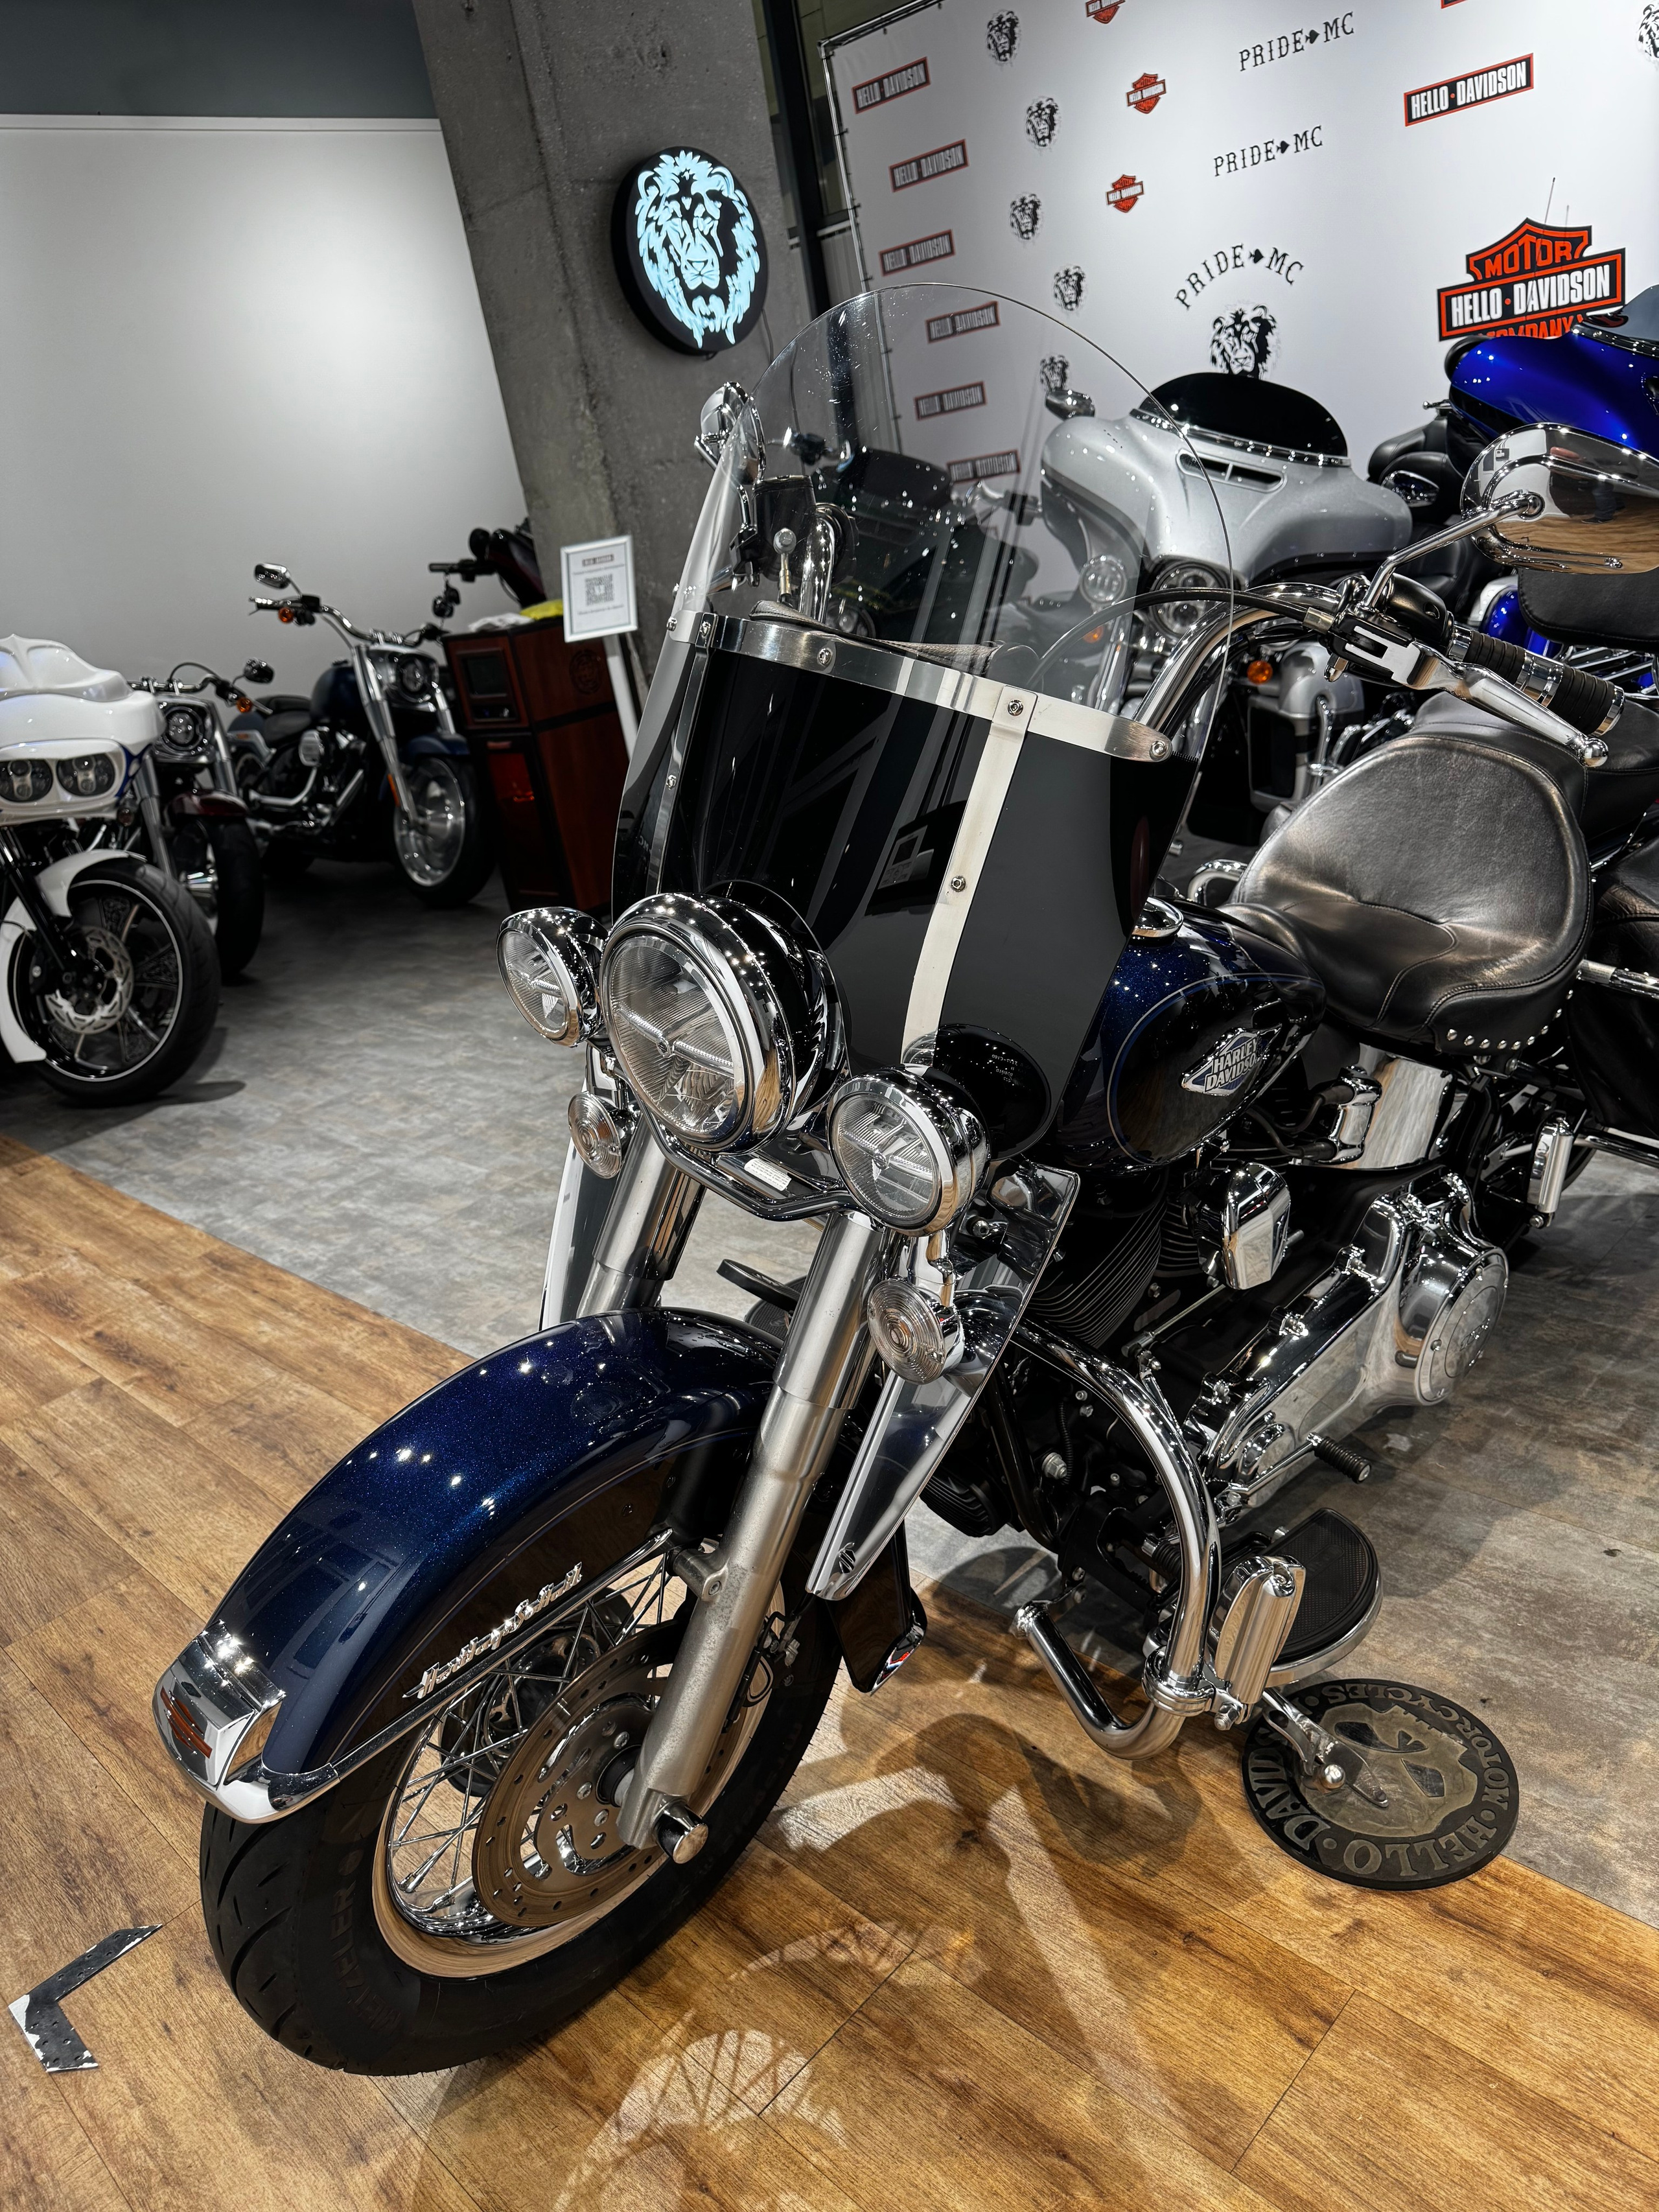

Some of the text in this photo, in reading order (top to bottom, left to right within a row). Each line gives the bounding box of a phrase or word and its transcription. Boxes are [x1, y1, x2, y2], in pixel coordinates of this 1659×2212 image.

[1238, 11, 1354, 72] PRIDE MC
[1411, 61, 1527, 119] HELLO DAVIDSON
[1213, 125, 1323, 177] PRIDE MC
[1174, 242, 1305, 311] PRIDE MC
[1485, 234, 1572, 279] MOTOR
[1451, 264, 1610, 328] HELLO DAVIDSON
[1205, 1052, 1259, 1091] DAVIDSO
[1213, 1038, 1257, 1073] HARLEY
[1321, 1683, 1510, 1810] MOTORCYCLES
[1343, 1815, 1498, 1877] HELLO
